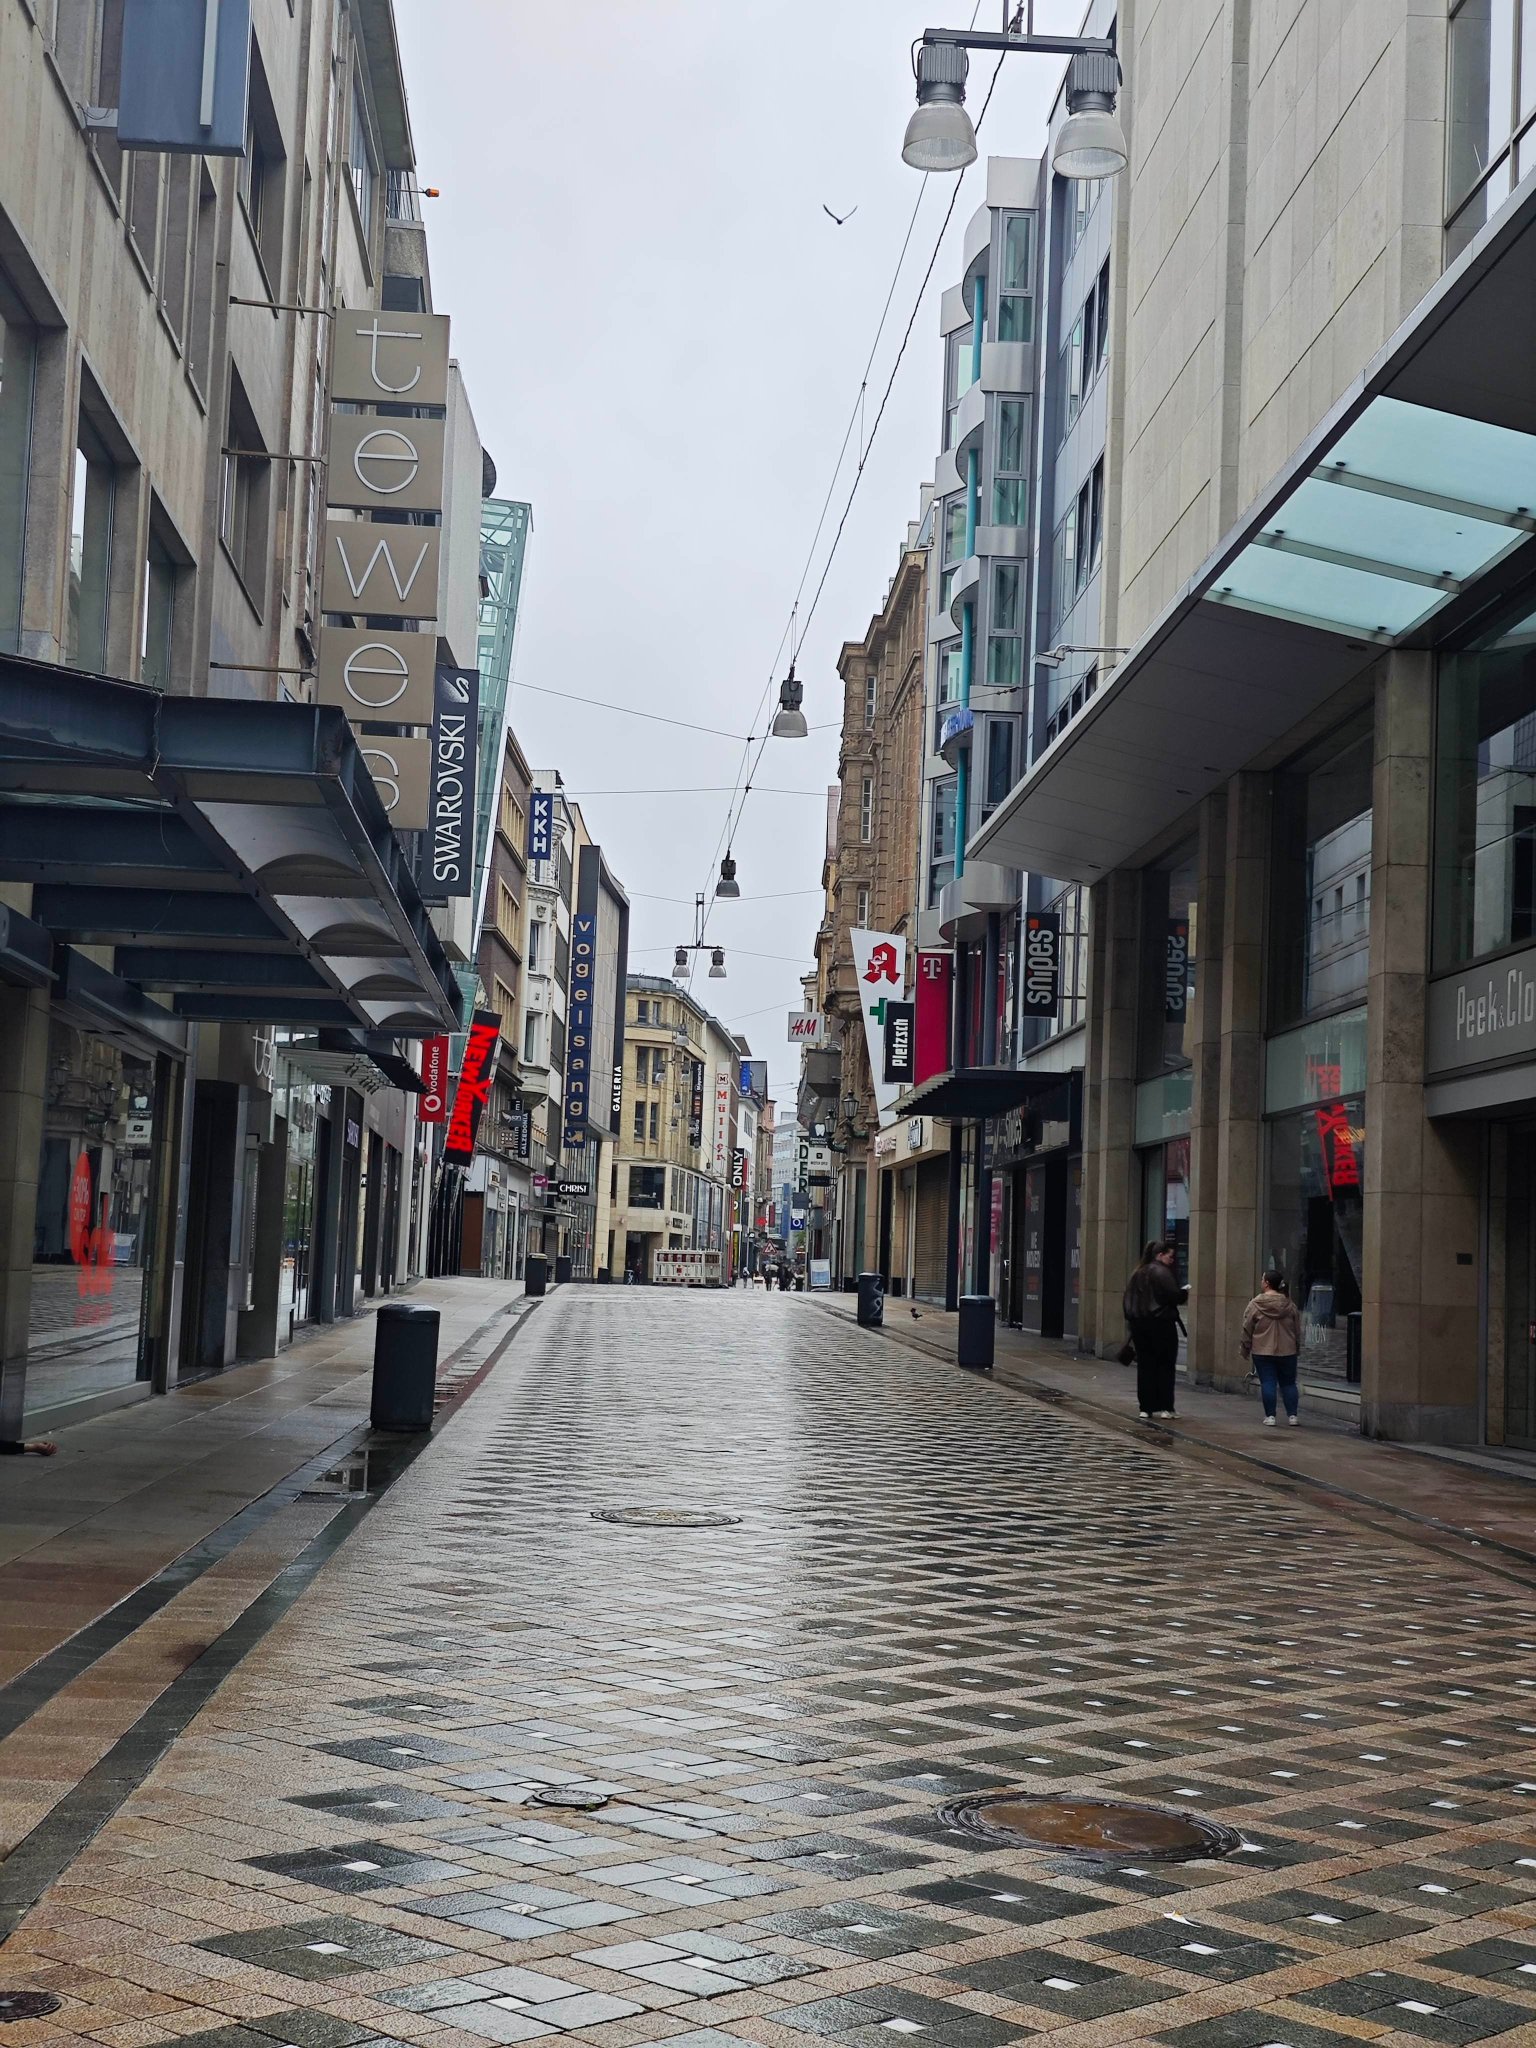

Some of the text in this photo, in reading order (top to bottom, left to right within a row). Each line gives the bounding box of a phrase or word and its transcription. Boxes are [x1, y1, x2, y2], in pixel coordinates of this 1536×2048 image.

[432, 714, 467, 882] SWAROVSKI
[533, 799, 549, 854] KKH
[923, 957, 942, 980] T
[1027, 929, 1058, 1005] snipes
[568, 920, 592, 1117] vogelsang
[791, 1018, 817, 1036] H&M
[1456, 980, 1498, 1041] Peek
[1506, 968, 1535, 1028] Clo
[891, 1018, 909, 1067] Pletzsch
[429, 1045, 440, 1093] vodafone
[446, 1023, 500, 1152] NEW YORKER
[612, 1065, 623, 1112] GALERIA
[521, 1112, 529, 1155] CALZEDONIA
[716, 1090, 728, 1161] Müller
[732, 1150, 744, 1187] ONLY
